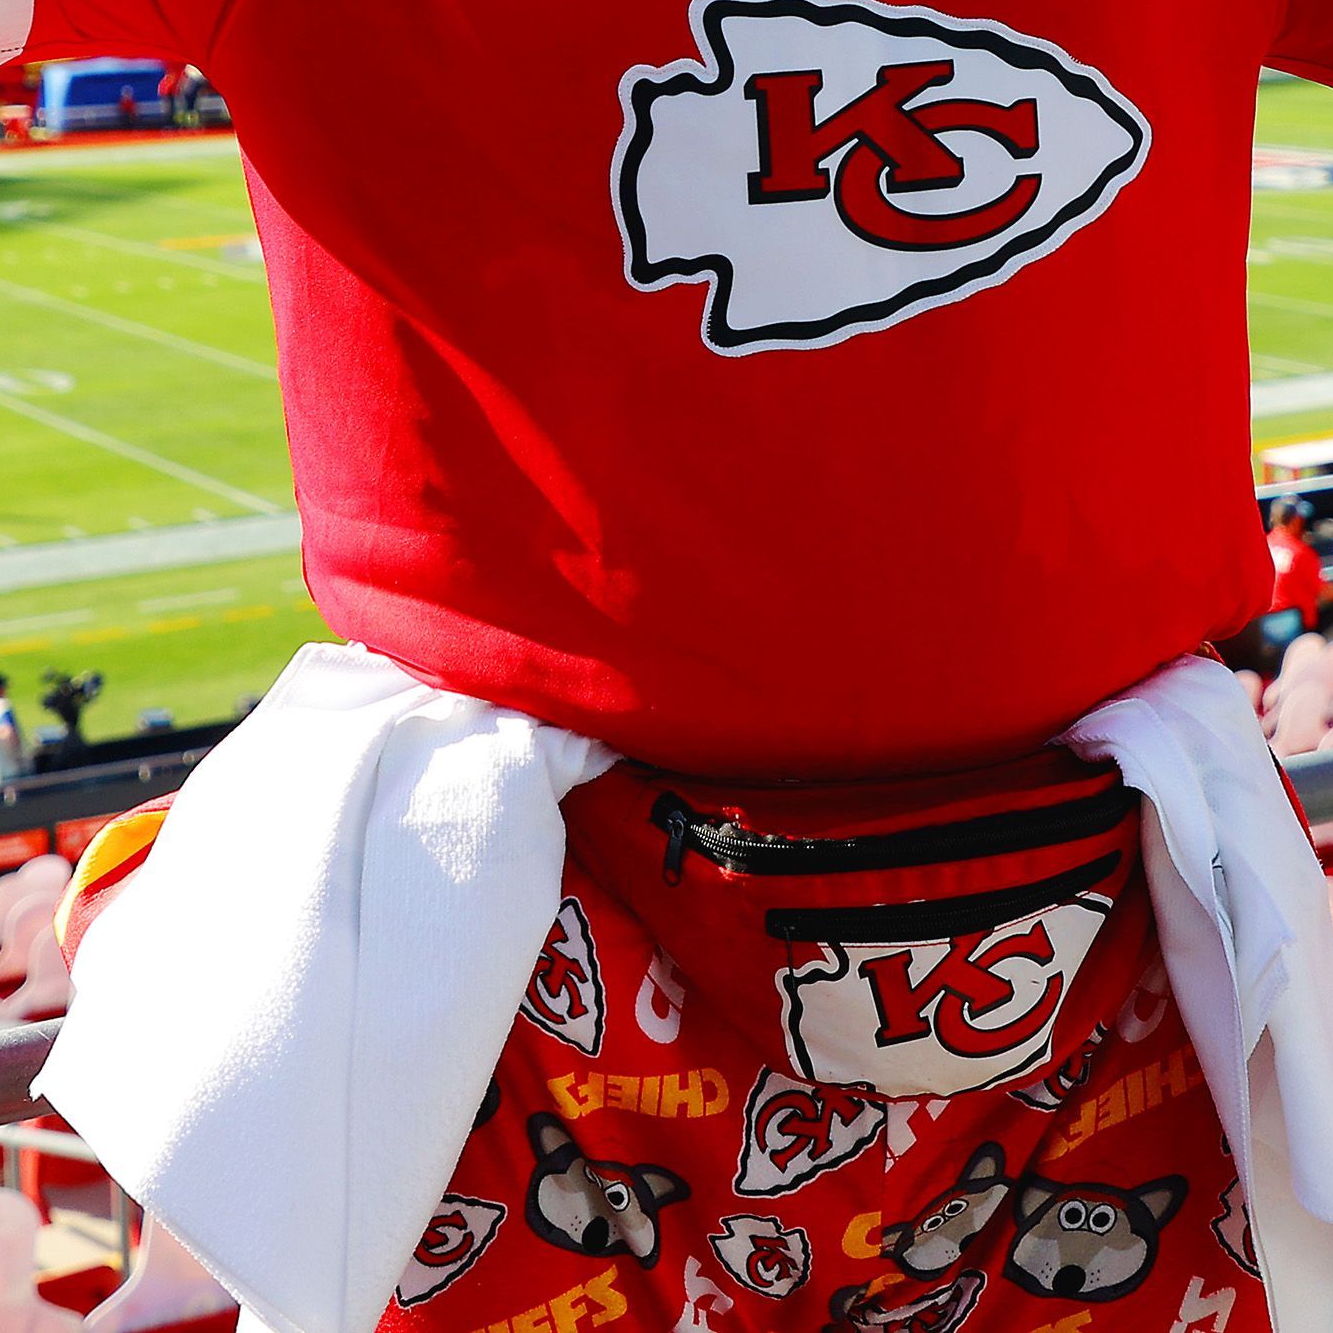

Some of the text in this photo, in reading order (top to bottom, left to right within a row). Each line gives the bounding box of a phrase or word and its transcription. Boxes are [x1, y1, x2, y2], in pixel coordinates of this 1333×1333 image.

[743, 59, 1043, 253] KC
[857, 918, 1065, 1059] KC
[547, 1067, 730, 1120] CHIEFS
[755, 1087, 866, 1174] KC
[413, 1209, 475, 1267] C
